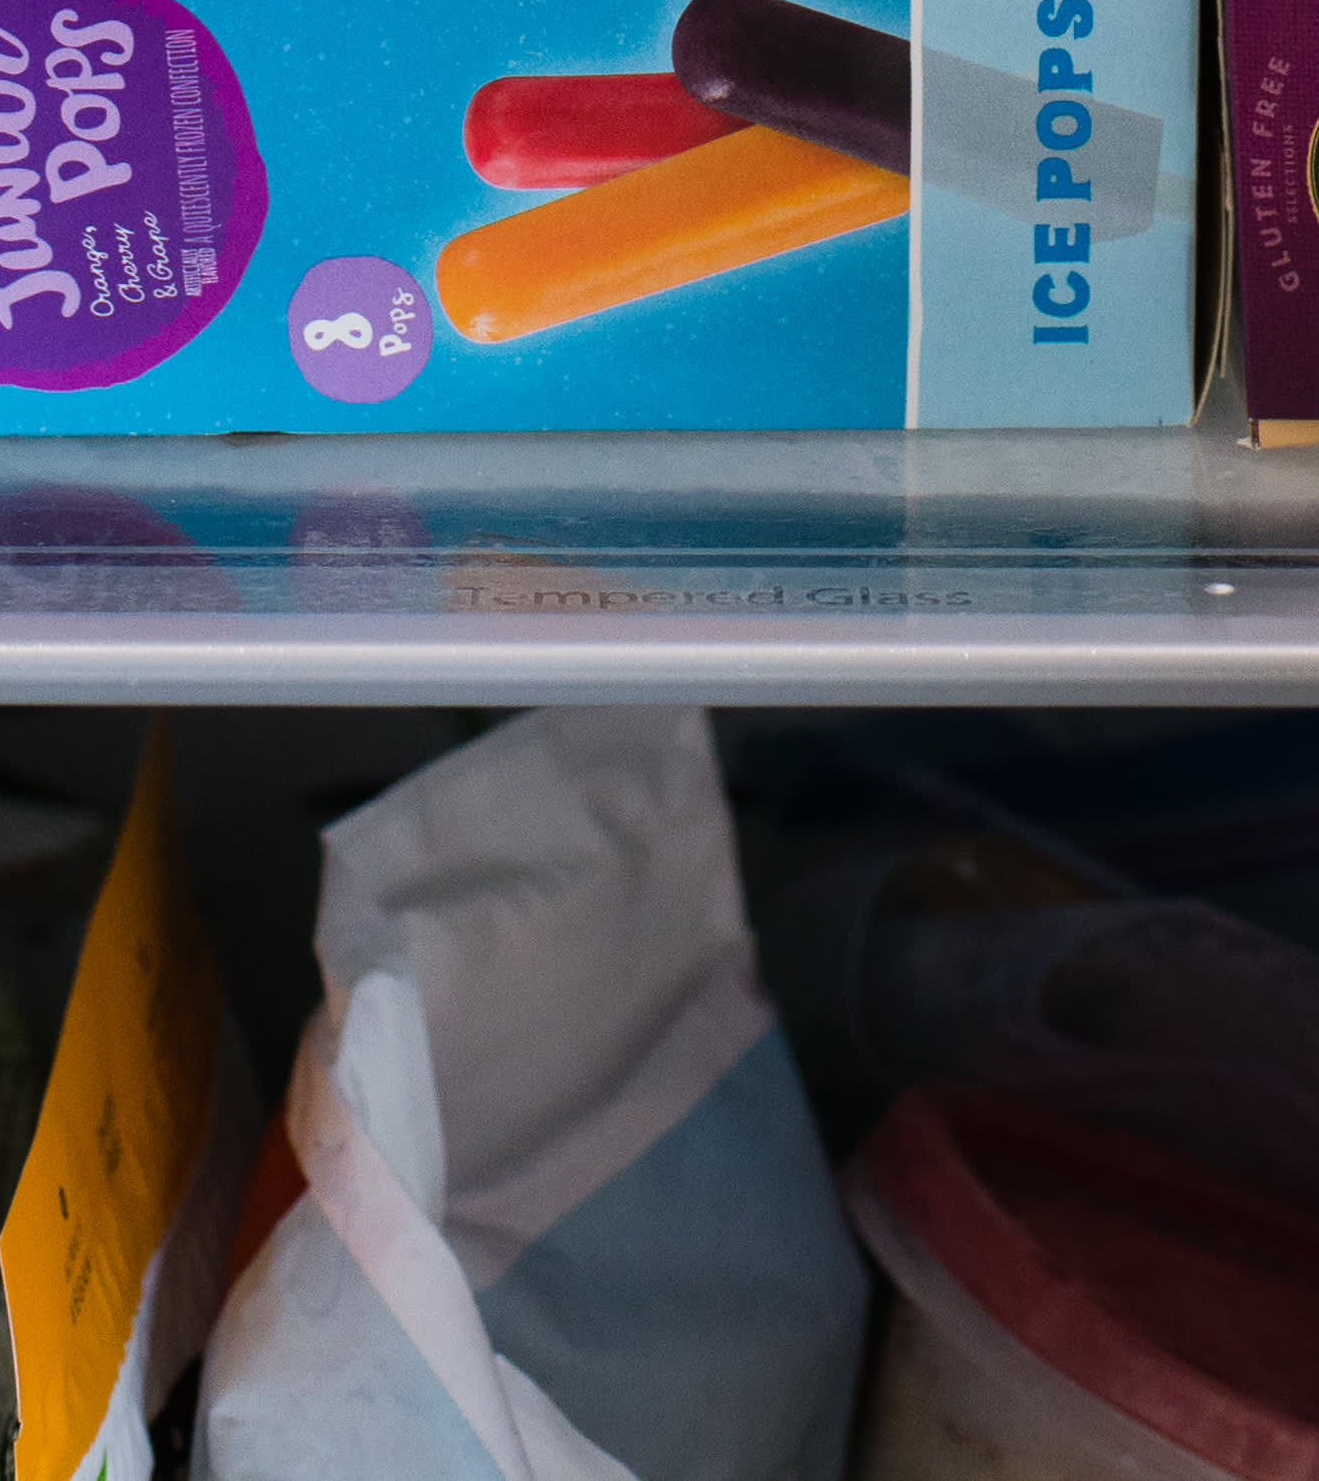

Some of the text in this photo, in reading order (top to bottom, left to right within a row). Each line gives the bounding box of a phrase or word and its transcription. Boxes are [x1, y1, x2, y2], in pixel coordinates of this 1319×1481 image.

[165, 28, 223, 243] A QUIESCENTLY FROZEN CONFECTION
[1250, 55, 1302, 294] GLUTEN FREE
[81, 225, 115, 317] Orange,
[113, 223, 146, 303] Cherry
[143, 210, 178, 299] & Grape
[1032, 220, 1092, 346] ICE
[302, 309, 374, 352] 8
[453, 582, 973, 614] Tempered Glass
